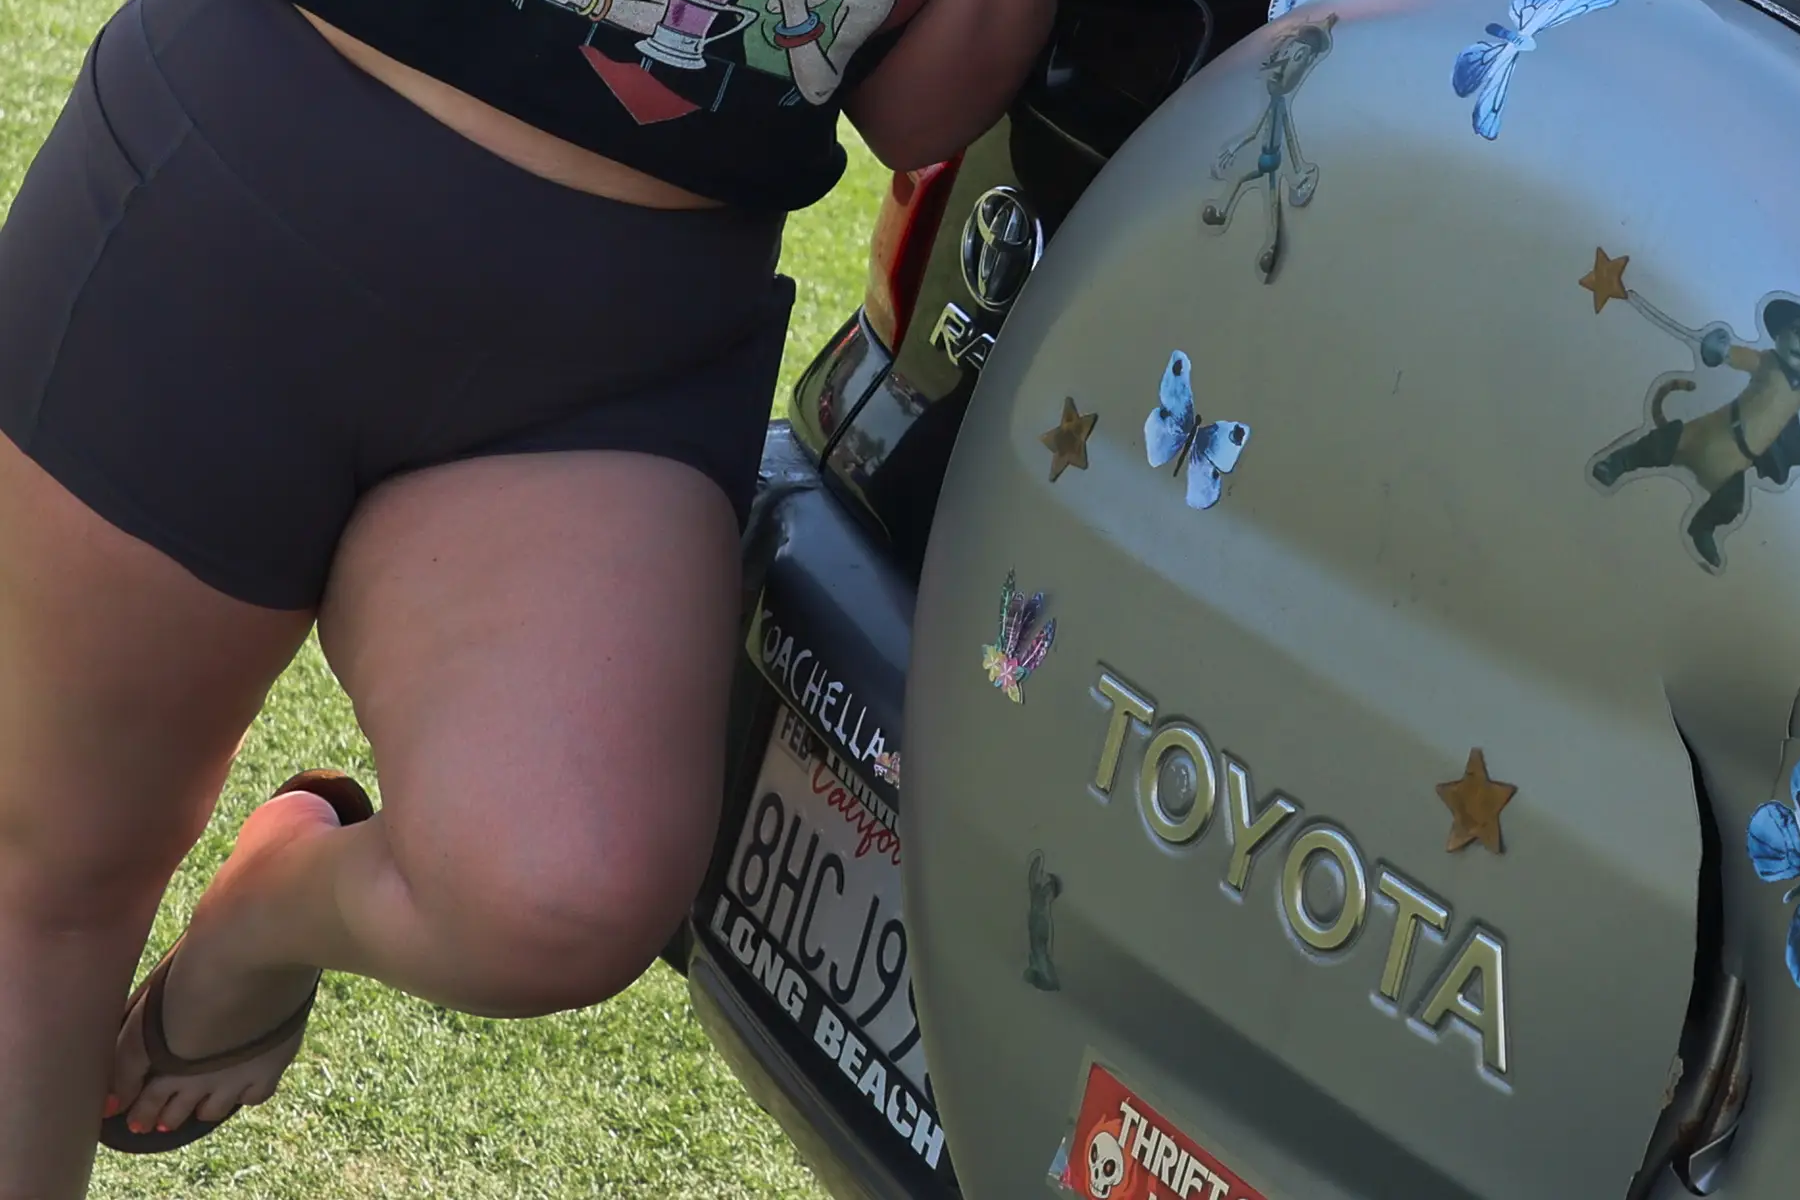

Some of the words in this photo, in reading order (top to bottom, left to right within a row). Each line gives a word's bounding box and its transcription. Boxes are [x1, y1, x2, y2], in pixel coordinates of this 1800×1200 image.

[760, 608, 888, 761] OACHELLA
[737, 792, 926, 1066] 8HCJ9
[1093, 672, 1508, 1075] TOYOTA
[710, 893, 808, 1023] LONG
[813, 1004, 945, 1170] BEACH
[1116, 1099, 1230, 1200] THRIFT
